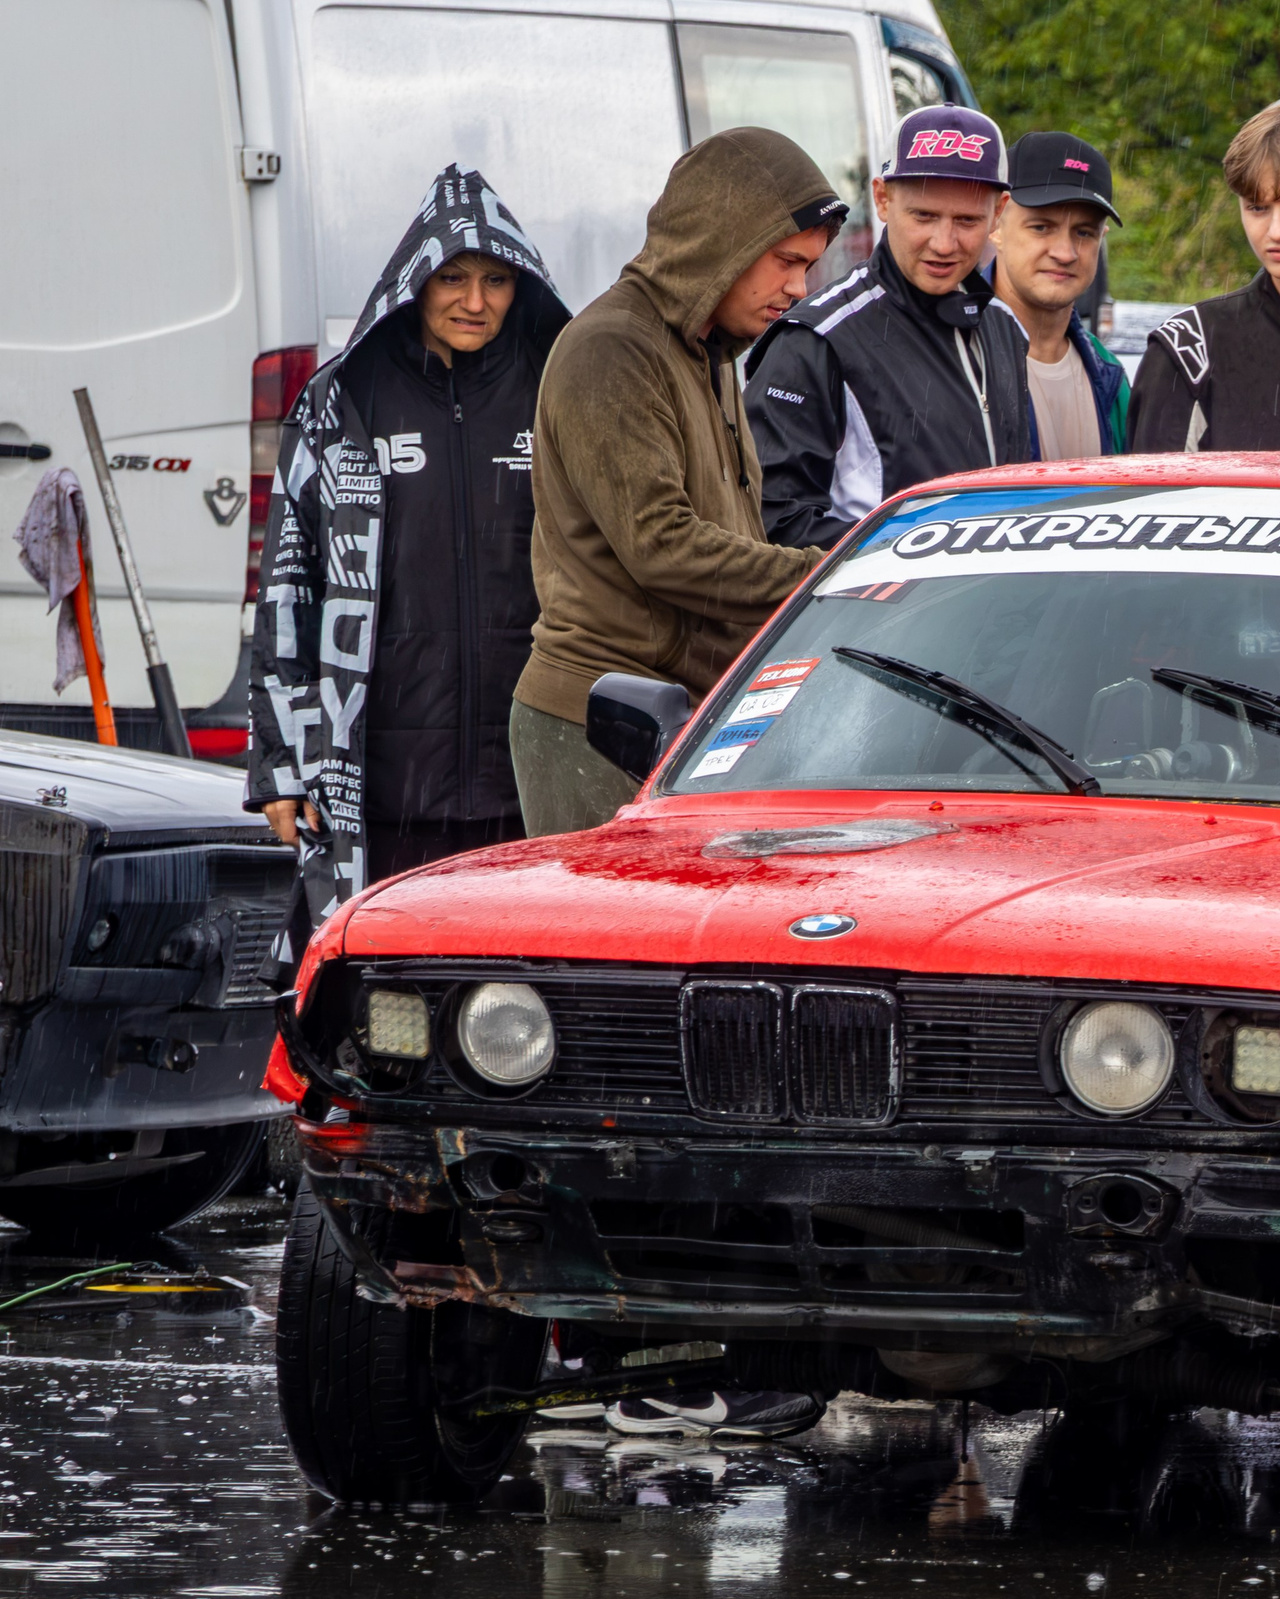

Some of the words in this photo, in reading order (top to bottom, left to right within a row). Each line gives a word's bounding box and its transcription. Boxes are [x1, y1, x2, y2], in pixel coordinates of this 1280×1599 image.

[766, 386, 805, 405] VOLSON
[109, 455, 150, 471] 315
[152, 457, 193, 473] CDI
[338, 462, 366, 473] BUT
[335, 493, 380, 505] EDITIO
